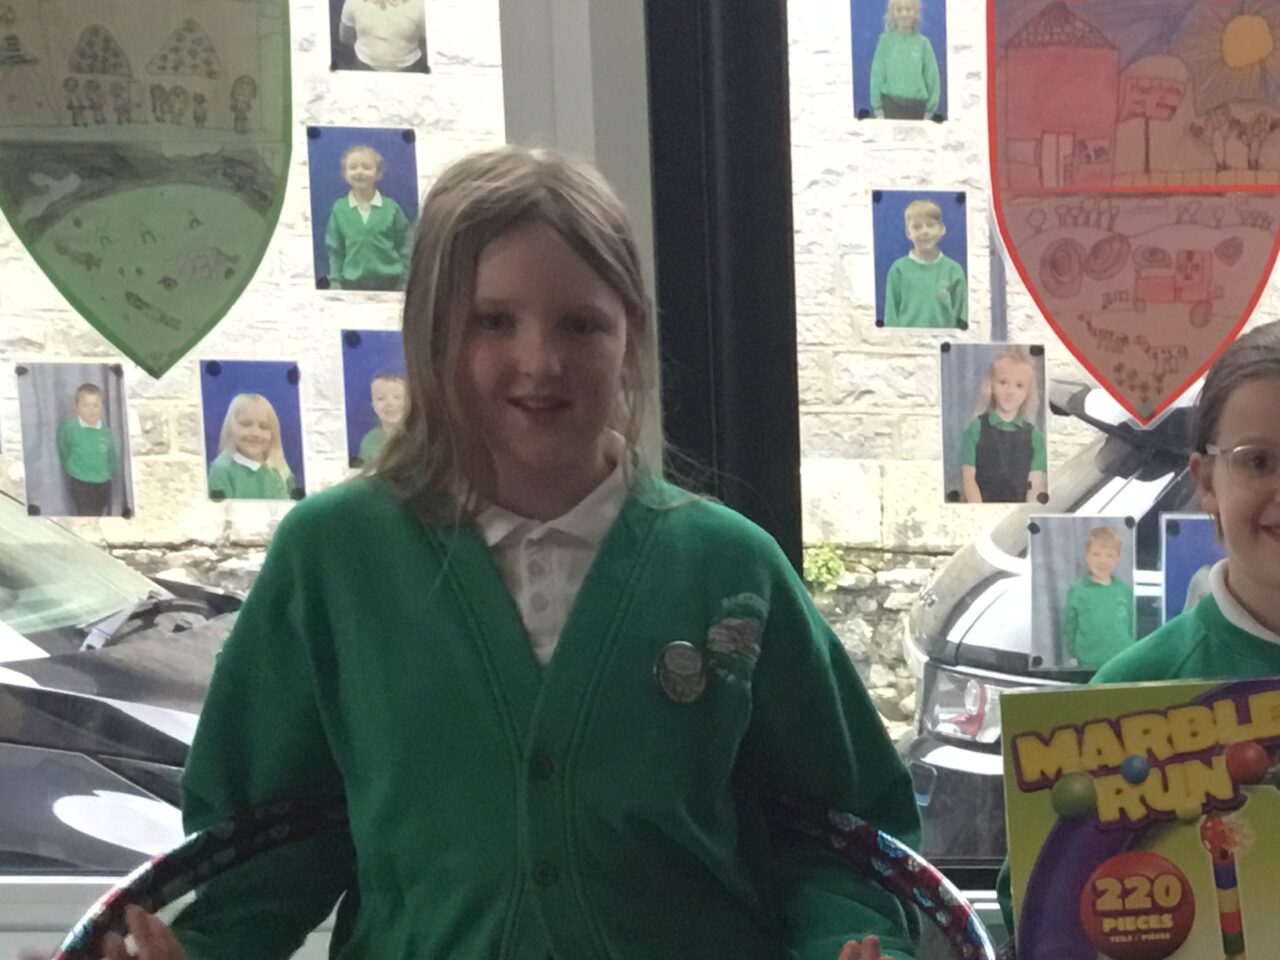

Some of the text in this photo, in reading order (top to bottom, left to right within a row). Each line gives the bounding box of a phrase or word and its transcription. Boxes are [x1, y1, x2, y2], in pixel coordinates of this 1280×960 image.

[1092, 754, 1234, 825] RUN
[1095, 874, 1182, 911] 220
[1102, 913, 1174, 933] PIECES
